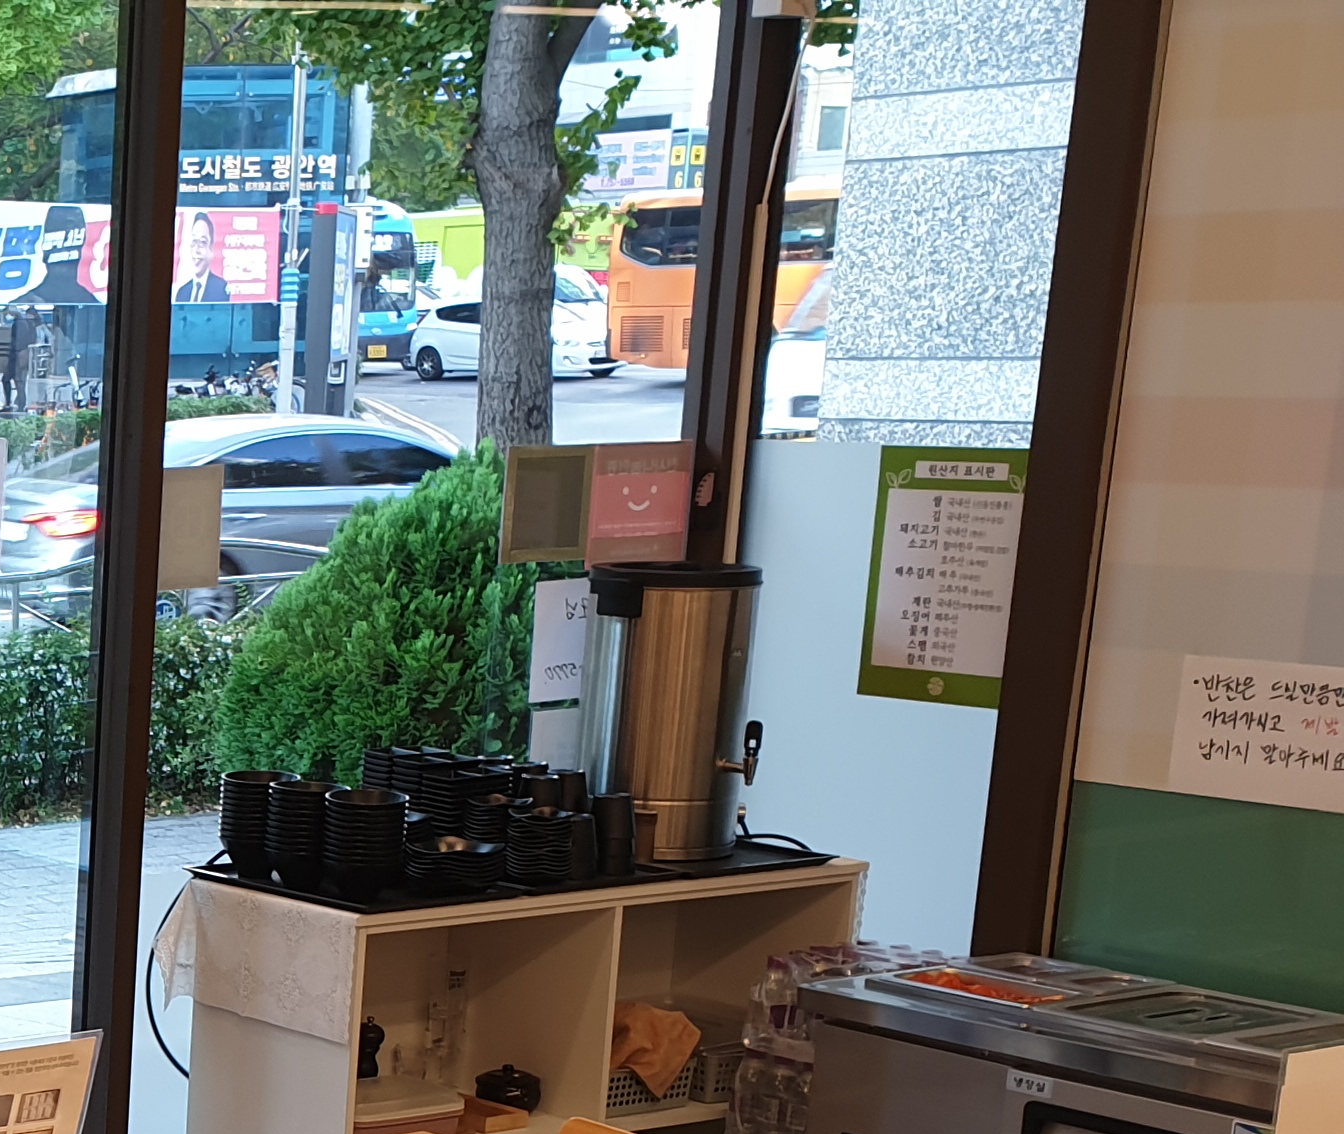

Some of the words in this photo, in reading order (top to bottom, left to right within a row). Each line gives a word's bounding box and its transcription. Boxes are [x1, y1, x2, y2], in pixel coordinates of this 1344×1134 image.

[180, 155, 262, 179] 도시철도
[271, 154, 337, 178] 광안역
[928, 464, 959, 477] 원산지
[963, 465, 996, 478] 표시판
[899, 523, 940, 536] 돼지고기
[907, 539, 938, 551] 소고기
[900, 609, 930, 623] 오징어
[1201, 674, 1256, 703] 반찬은
[1301, 715, 1340, 736] 제발
[1198, 738, 1250, 765] 남기지
[1260, 743, 1344, 772] 말아주세요
[1012, 1076, 1046, 1093] 냉장실
